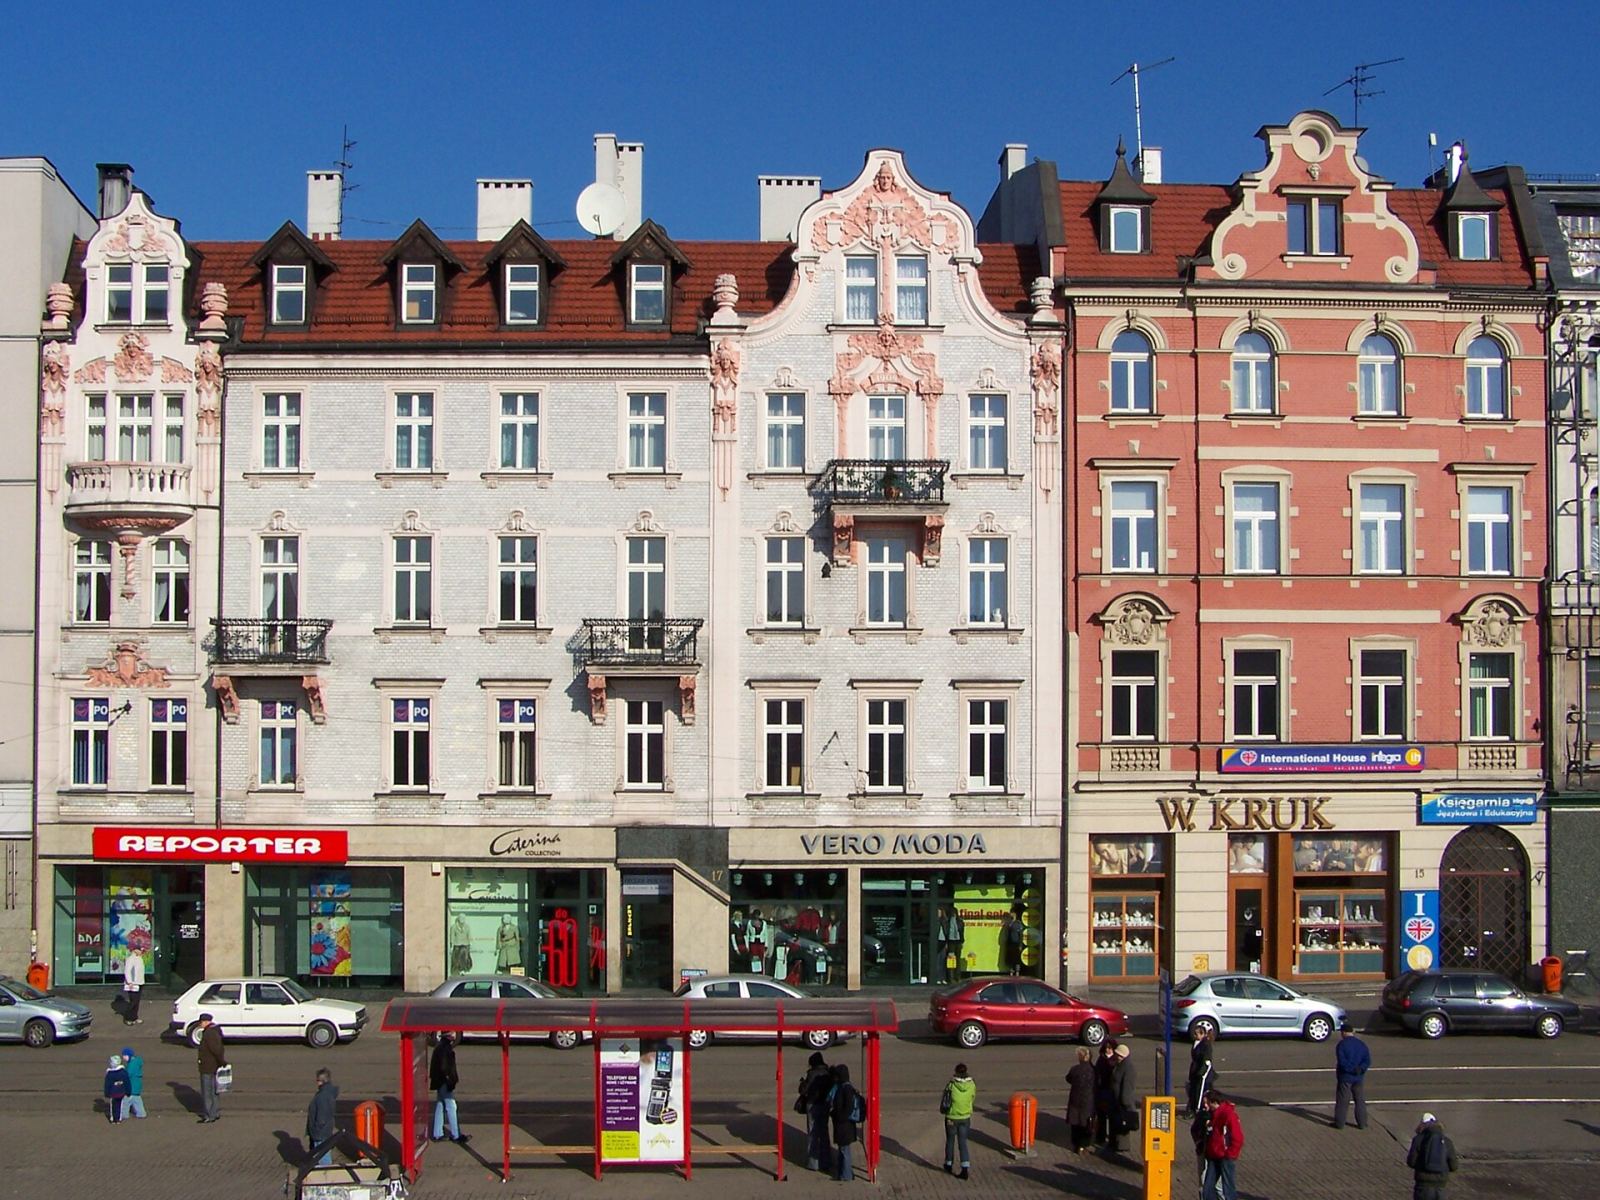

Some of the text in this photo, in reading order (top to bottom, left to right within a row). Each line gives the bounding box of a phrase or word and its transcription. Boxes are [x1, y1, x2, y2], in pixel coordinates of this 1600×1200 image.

[93, 705, 108, 716] PO
[172, 705, 186, 716] PO
[281, 705, 295, 716] PO
[413, 707, 429, 718] PO
[519, 706, 534, 717] PO
[1261, 754, 1330, 763] International
[1333, 753, 1367, 763] House
[1437, 798, 1510, 809] Księgarnia
[1156, 797, 1335, 831] W. KRUK
[118, 835, 321, 854] REPORTER
[489, 829, 561, 856] Caterina
[801, 833, 987, 855] VERO MODA
[712, 870, 723, 881] 17
[1415, 869, 1425, 879] 15
[1414, 893, 1425, 916] I
[959, 909, 983, 917] final
